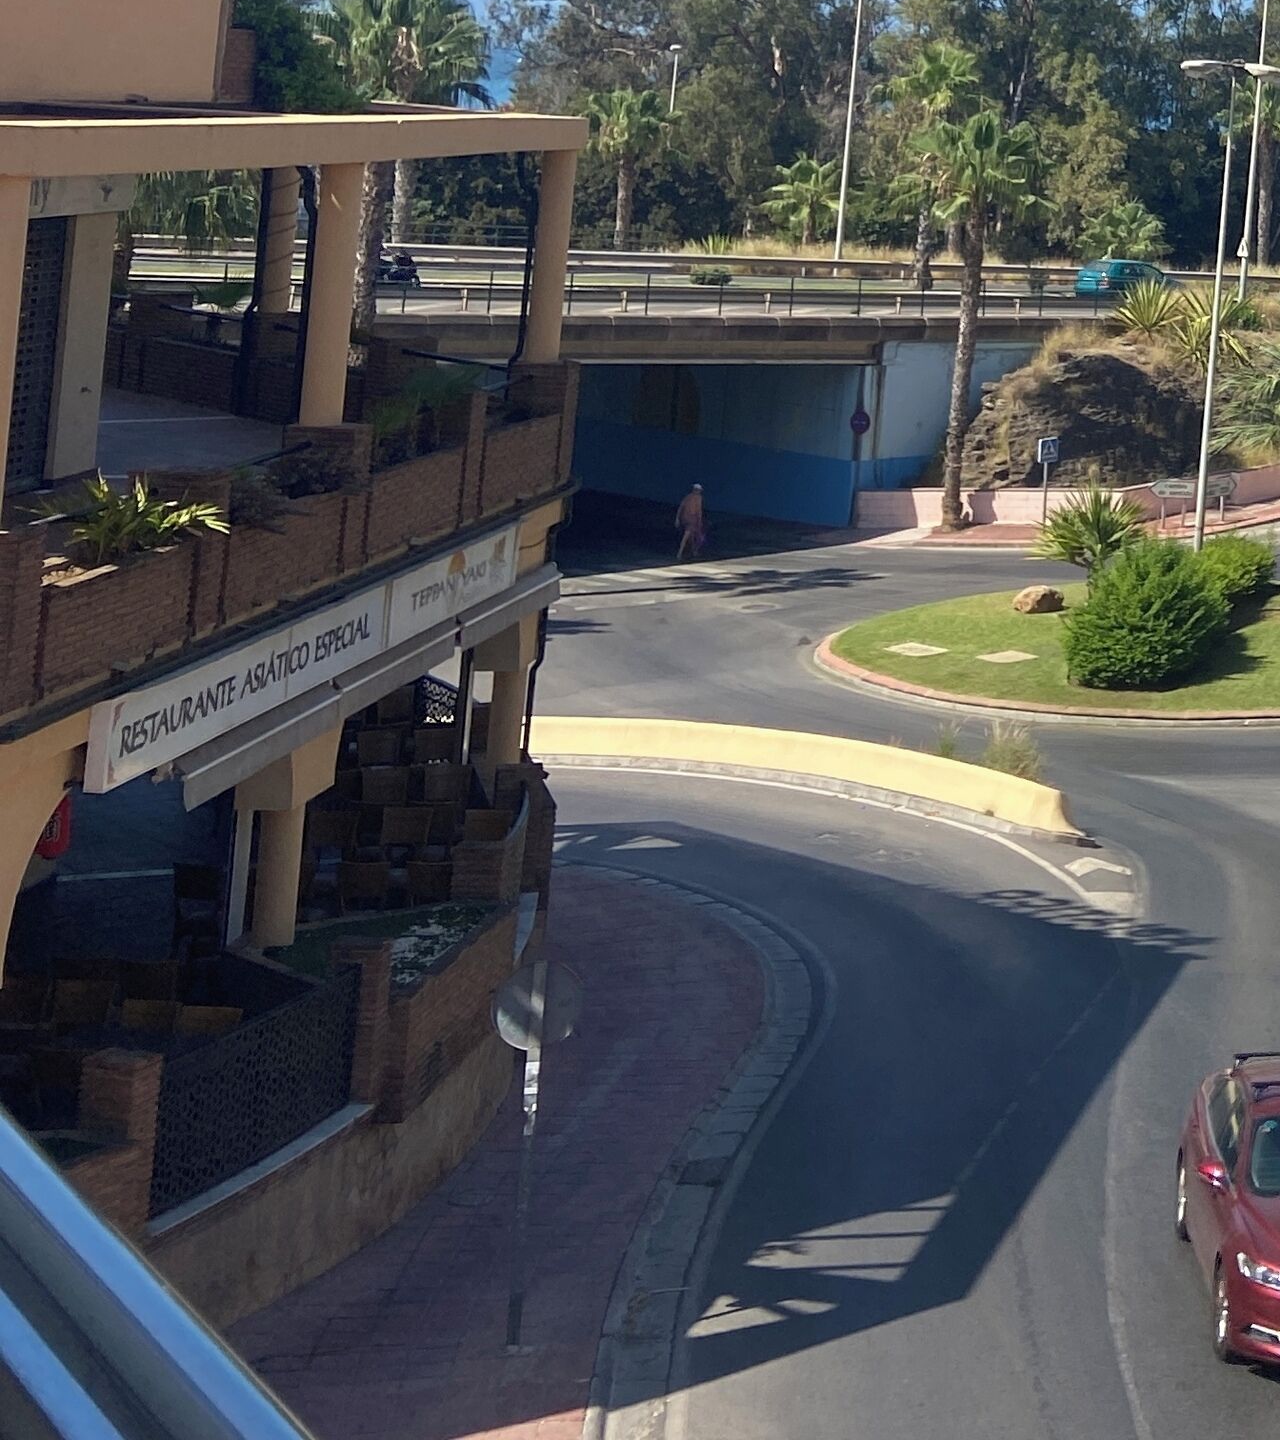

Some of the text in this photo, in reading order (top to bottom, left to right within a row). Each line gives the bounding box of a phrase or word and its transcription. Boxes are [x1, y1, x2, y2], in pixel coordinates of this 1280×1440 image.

[119, 612, 371, 759] RESTAURANTE ASIÁTICO ESPECIAL
